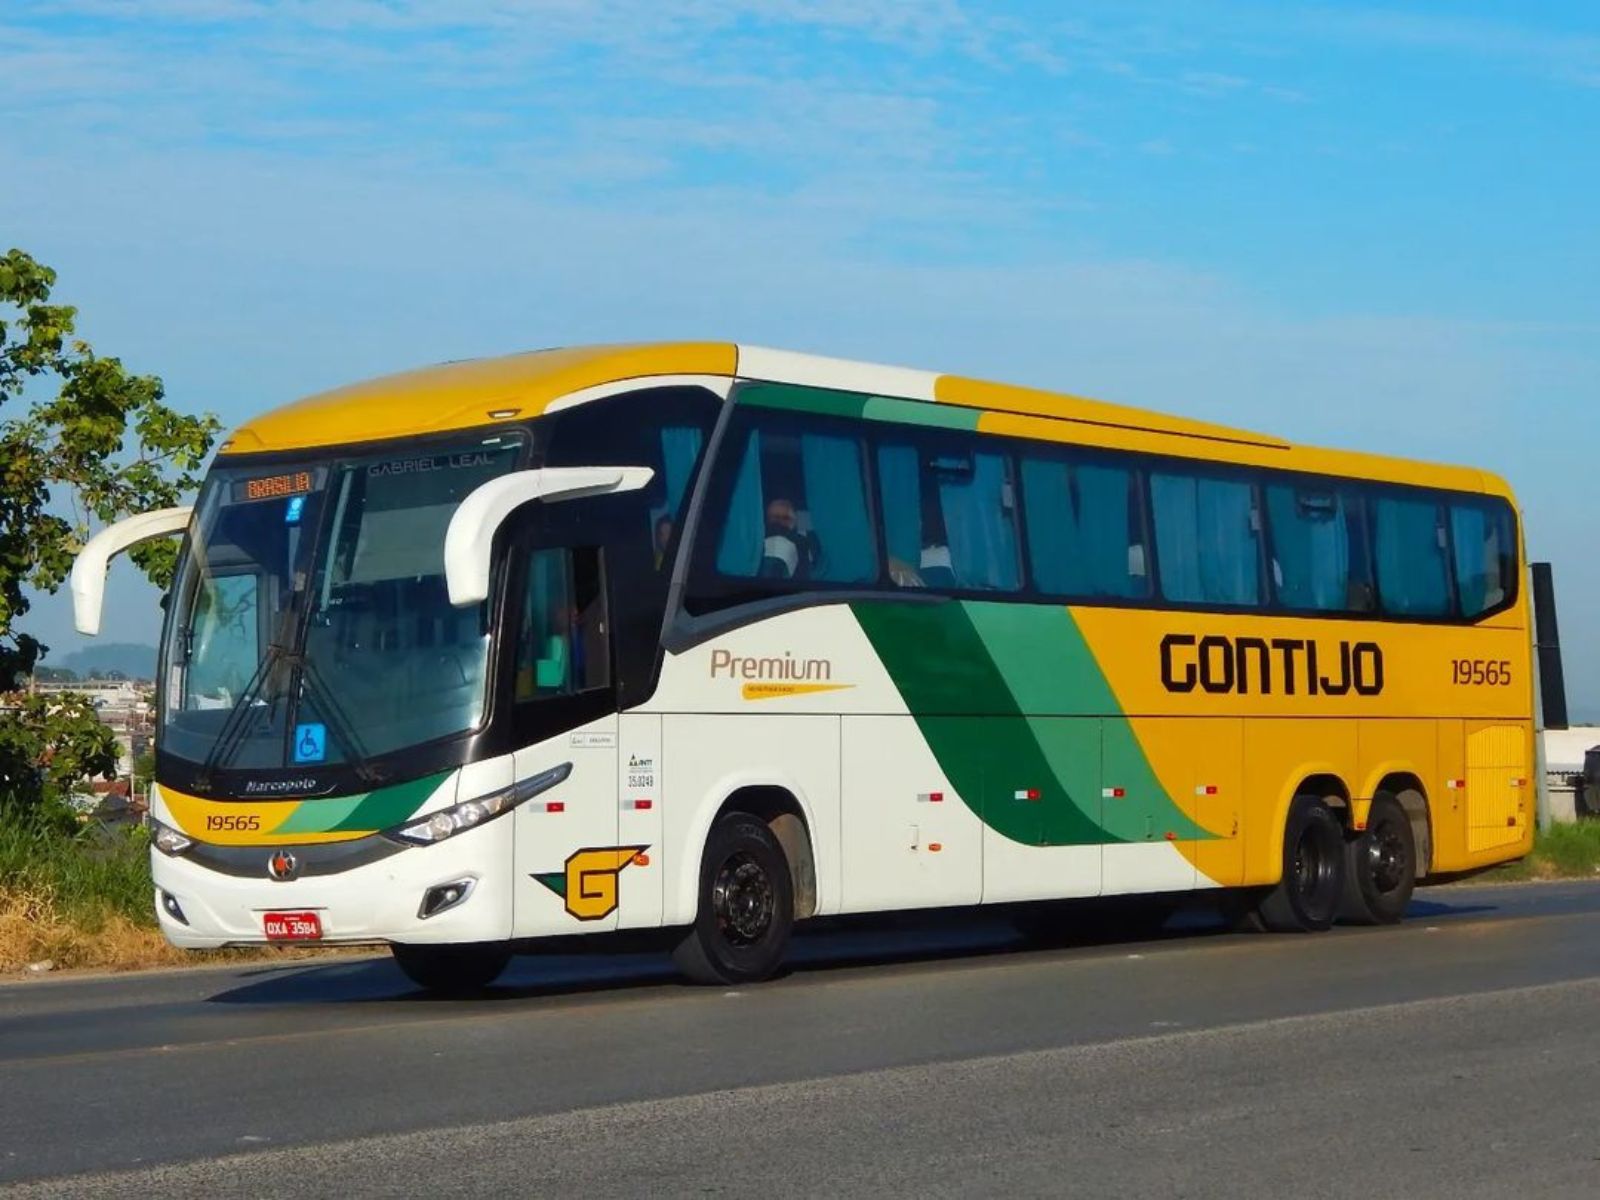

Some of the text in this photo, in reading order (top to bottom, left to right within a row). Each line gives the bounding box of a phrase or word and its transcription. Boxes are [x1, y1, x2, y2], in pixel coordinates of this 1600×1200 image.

[710, 649, 831, 680] Premium
[1160, 634, 1384, 695] GONTIJO
[1451, 659, 1511, 685] 19565
[246, 778, 317, 792] Marcopolo
[206, 815, 260, 831] 19565
